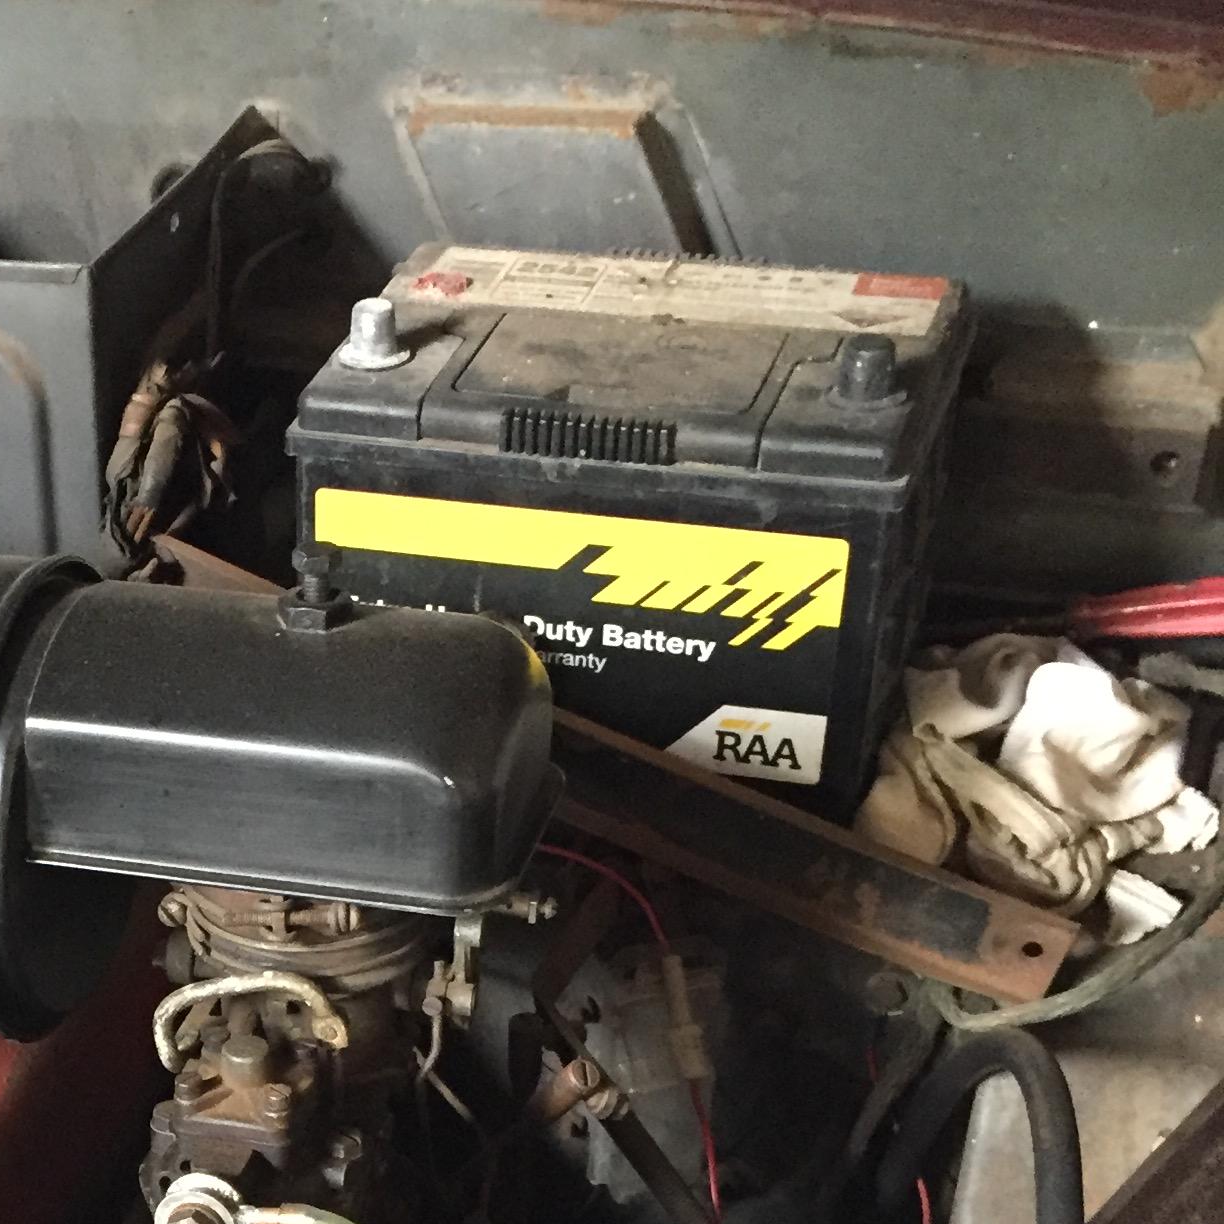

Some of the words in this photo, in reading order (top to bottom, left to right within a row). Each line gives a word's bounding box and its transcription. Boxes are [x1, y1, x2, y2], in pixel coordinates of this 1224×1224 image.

[537, 650, 607, 673] arranty
[602, 623, 717, 662] Battery
[713, 730, 802, 770] RAA
